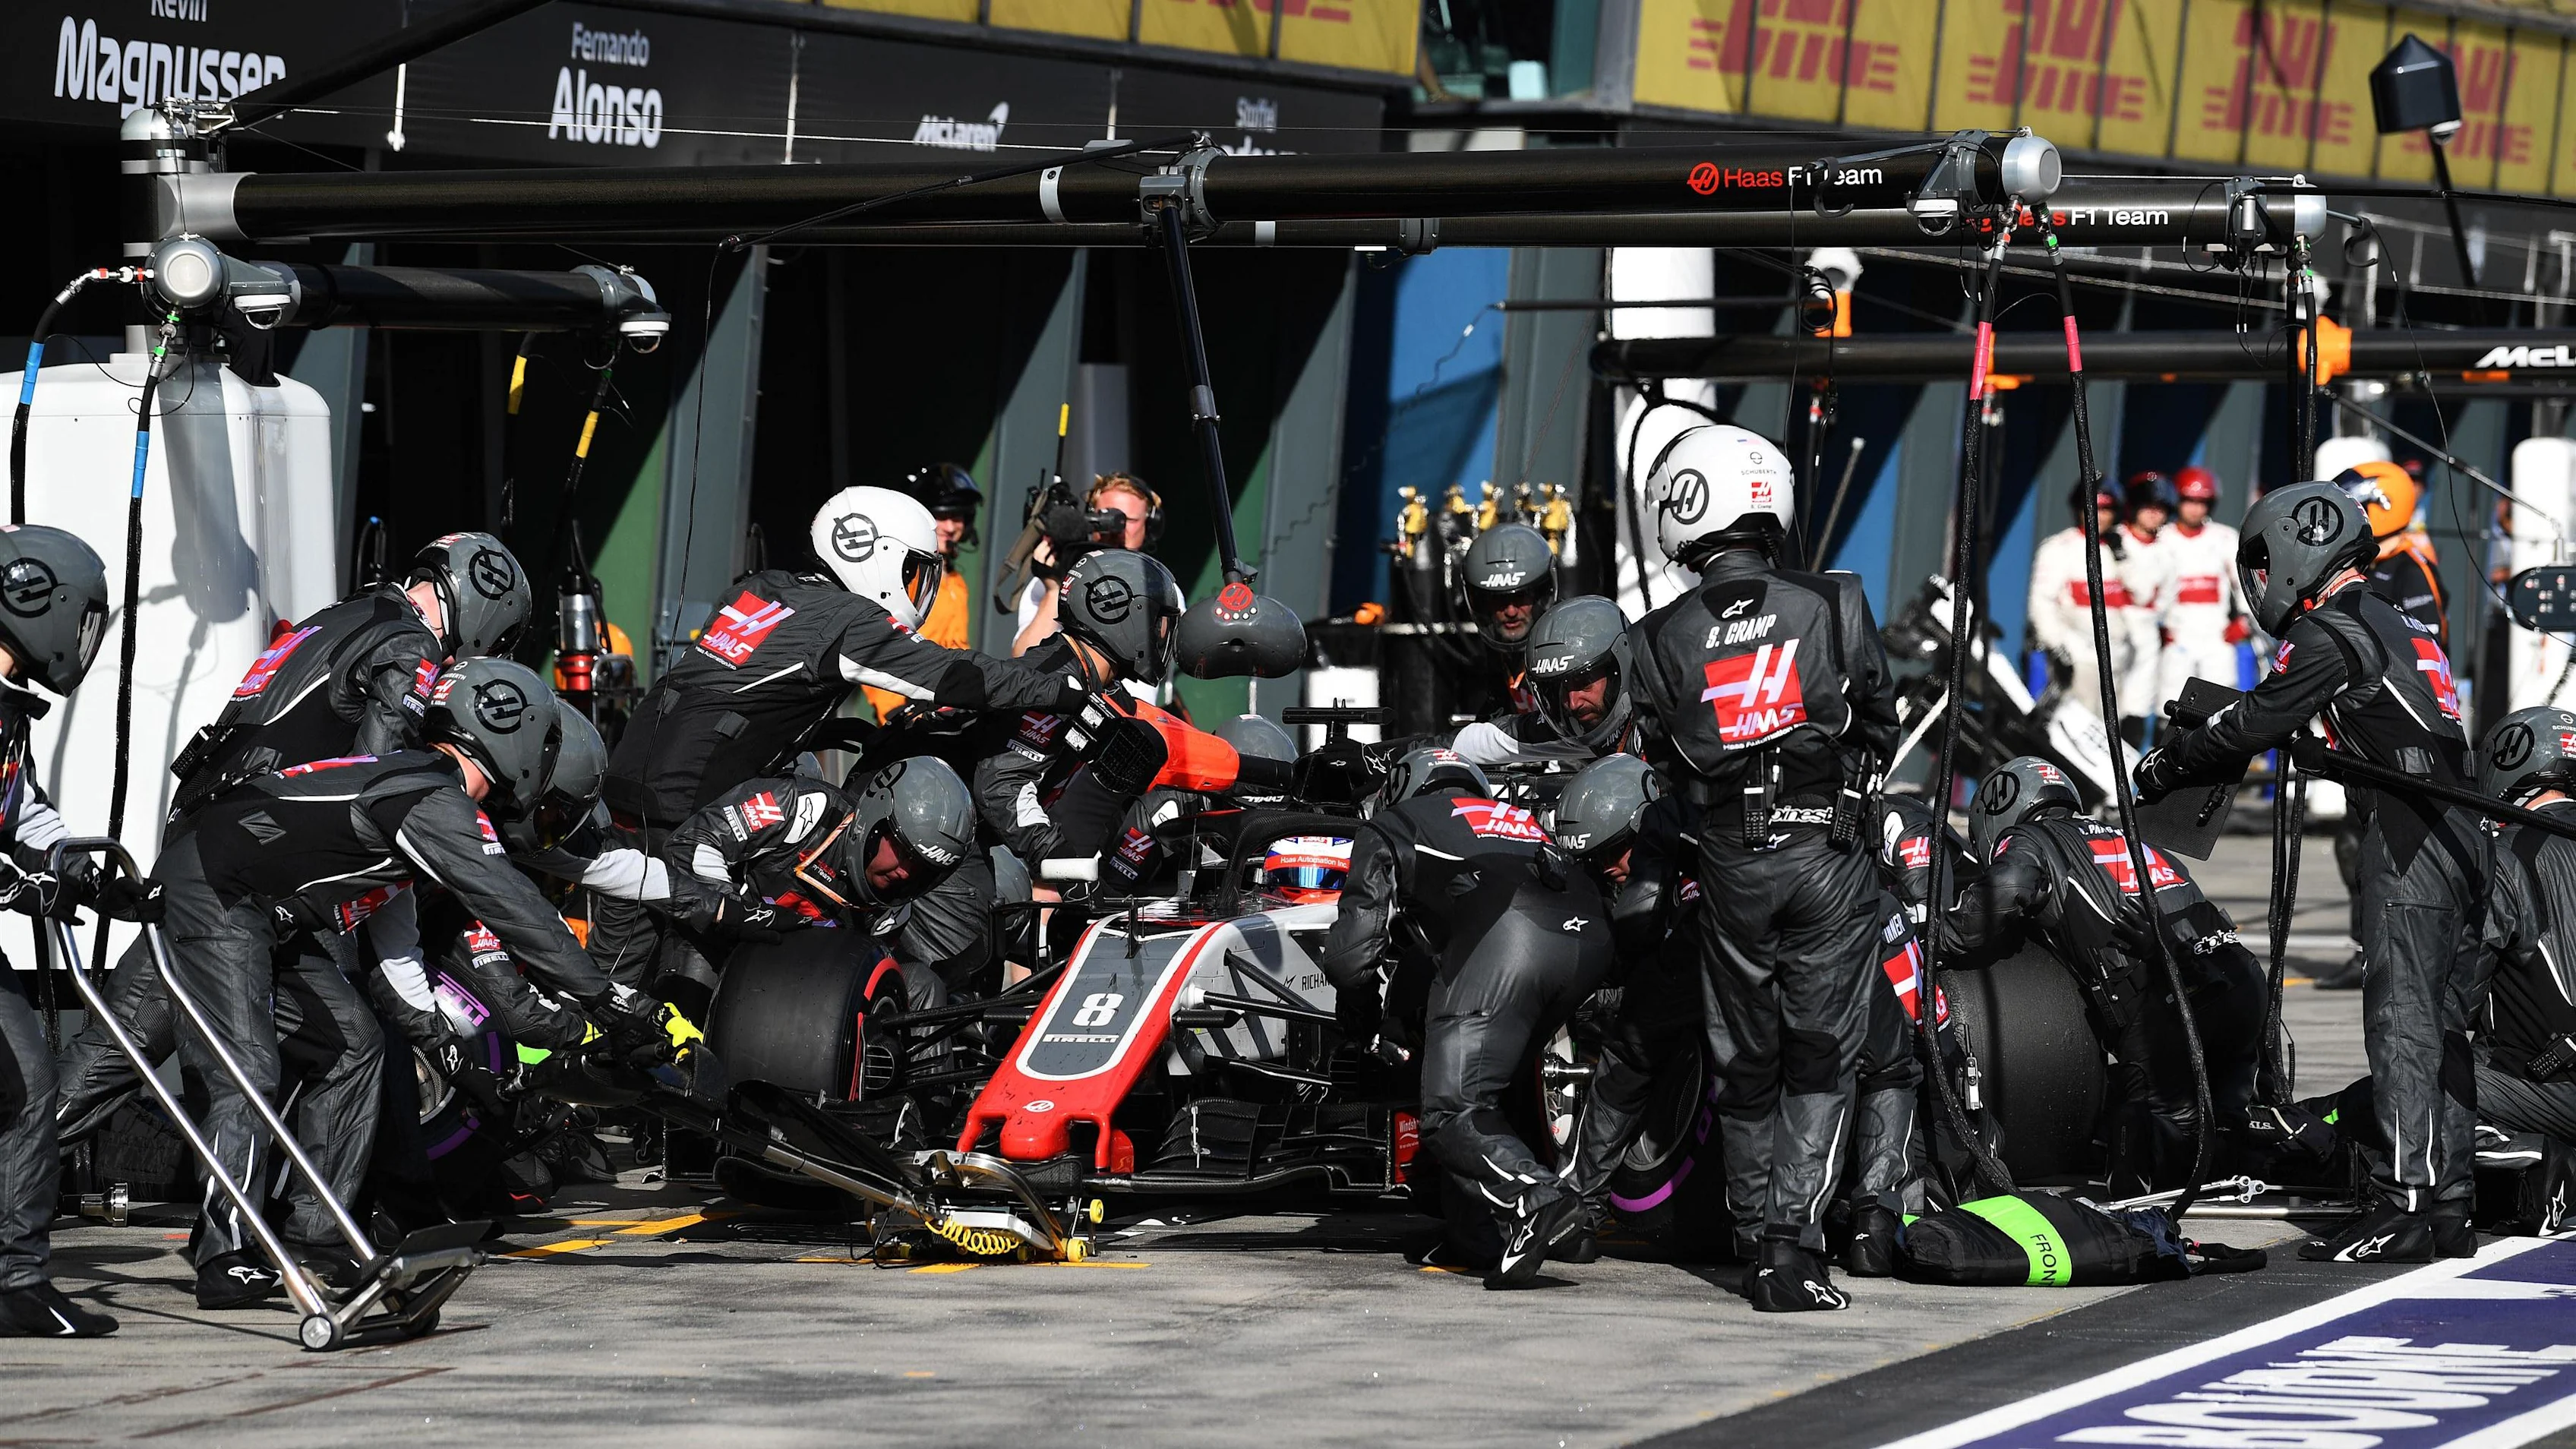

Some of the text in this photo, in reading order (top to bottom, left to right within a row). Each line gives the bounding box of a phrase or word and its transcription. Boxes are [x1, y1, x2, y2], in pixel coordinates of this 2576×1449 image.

[571, 21, 650, 68] Fernando
[548, 65, 663, 149] Alonso
[913, 102, 1009, 153] McLaren
[1724, 169, 1783, 188] Haas
[2071, 210, 2098, 226] F1
[2107, 209, 2168, 226] Team
[1480, 571, 1526, 588] HAAS
[1706, 614, 1777, 649] S. CRAMP
[703, 630, 754, 658] HAAS
[1531, 655, 1575, 674] HAAS
[1719, 702, 1804, 738] HAAS
[1019, 729, 1050, 744] HAAS
[1746, 725, 1793, 748] Automation
[1006, 738, 1046, 762] PIRELLI
[723, 805, 748, 842] PIRELLI
[1473, 819, 1547, 838] HAAS
[917, 843, 962, 867] HAAS
[1297, 857, 1337, 866] Automation
[471, 939, 501, 949] HAAS
[472, 951, 510, 970] PIRELLI
[1072, 993, 1124, 1026] 8
[1042, 1034, 1120, 1043] PIRELLI
